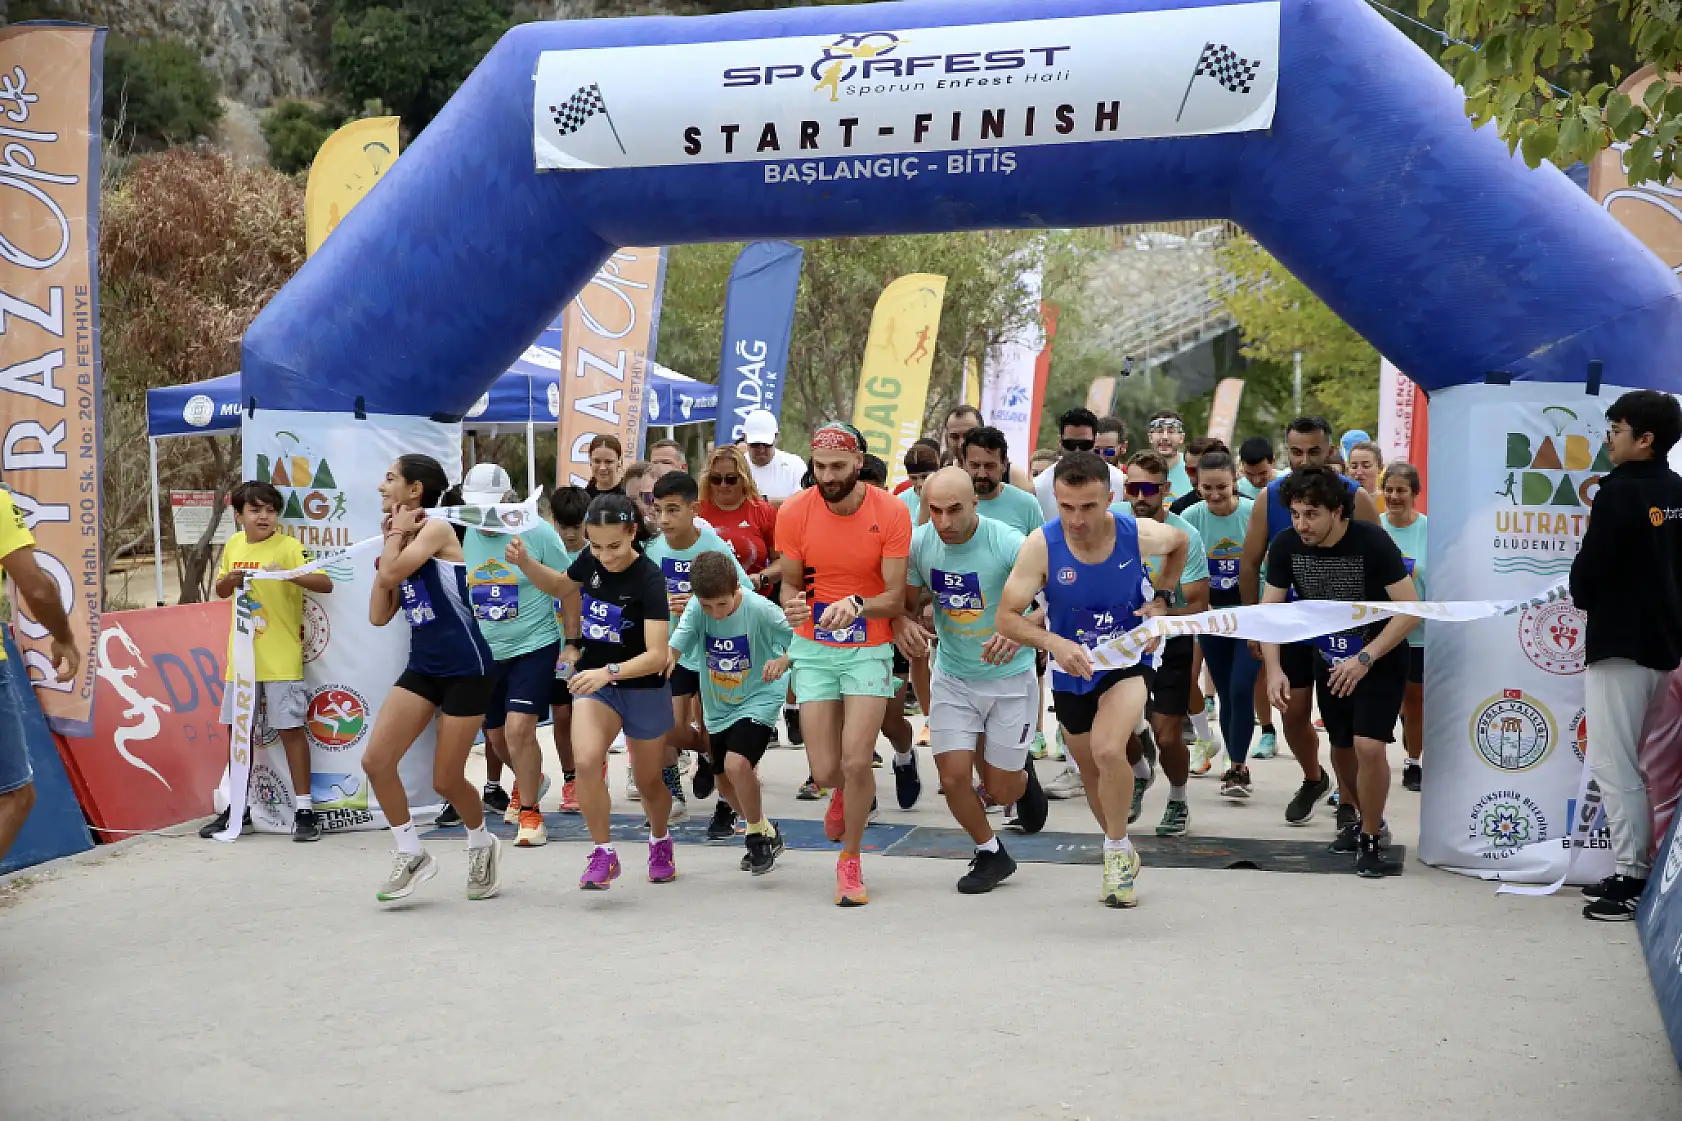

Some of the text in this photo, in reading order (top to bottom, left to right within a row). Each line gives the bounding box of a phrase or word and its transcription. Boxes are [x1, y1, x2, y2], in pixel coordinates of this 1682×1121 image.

[846, 69, 1070, 97] Sporun EnFest Hali
[764, 157, 920, 185] BAŞLANGIÇ
[947, 149, 1017, 174] BİTİŞ
[74, 285, 98, 699] Cumhuriyet Mah. 500 Sk. No: 20/B FETHİYE
[1493, 536, 1566, 552] ÖLÜDENİZ
[1217, 559, 1235, 572] 35
[943, 573, 965, 588] 52
[589, 600, 609, 617] 46
[1093, 610, 1114, 627] 74
[713, 639, 735, 652] 40
[1328, 635, 1348, 650] 18
[233, 673, 253, 766] START
